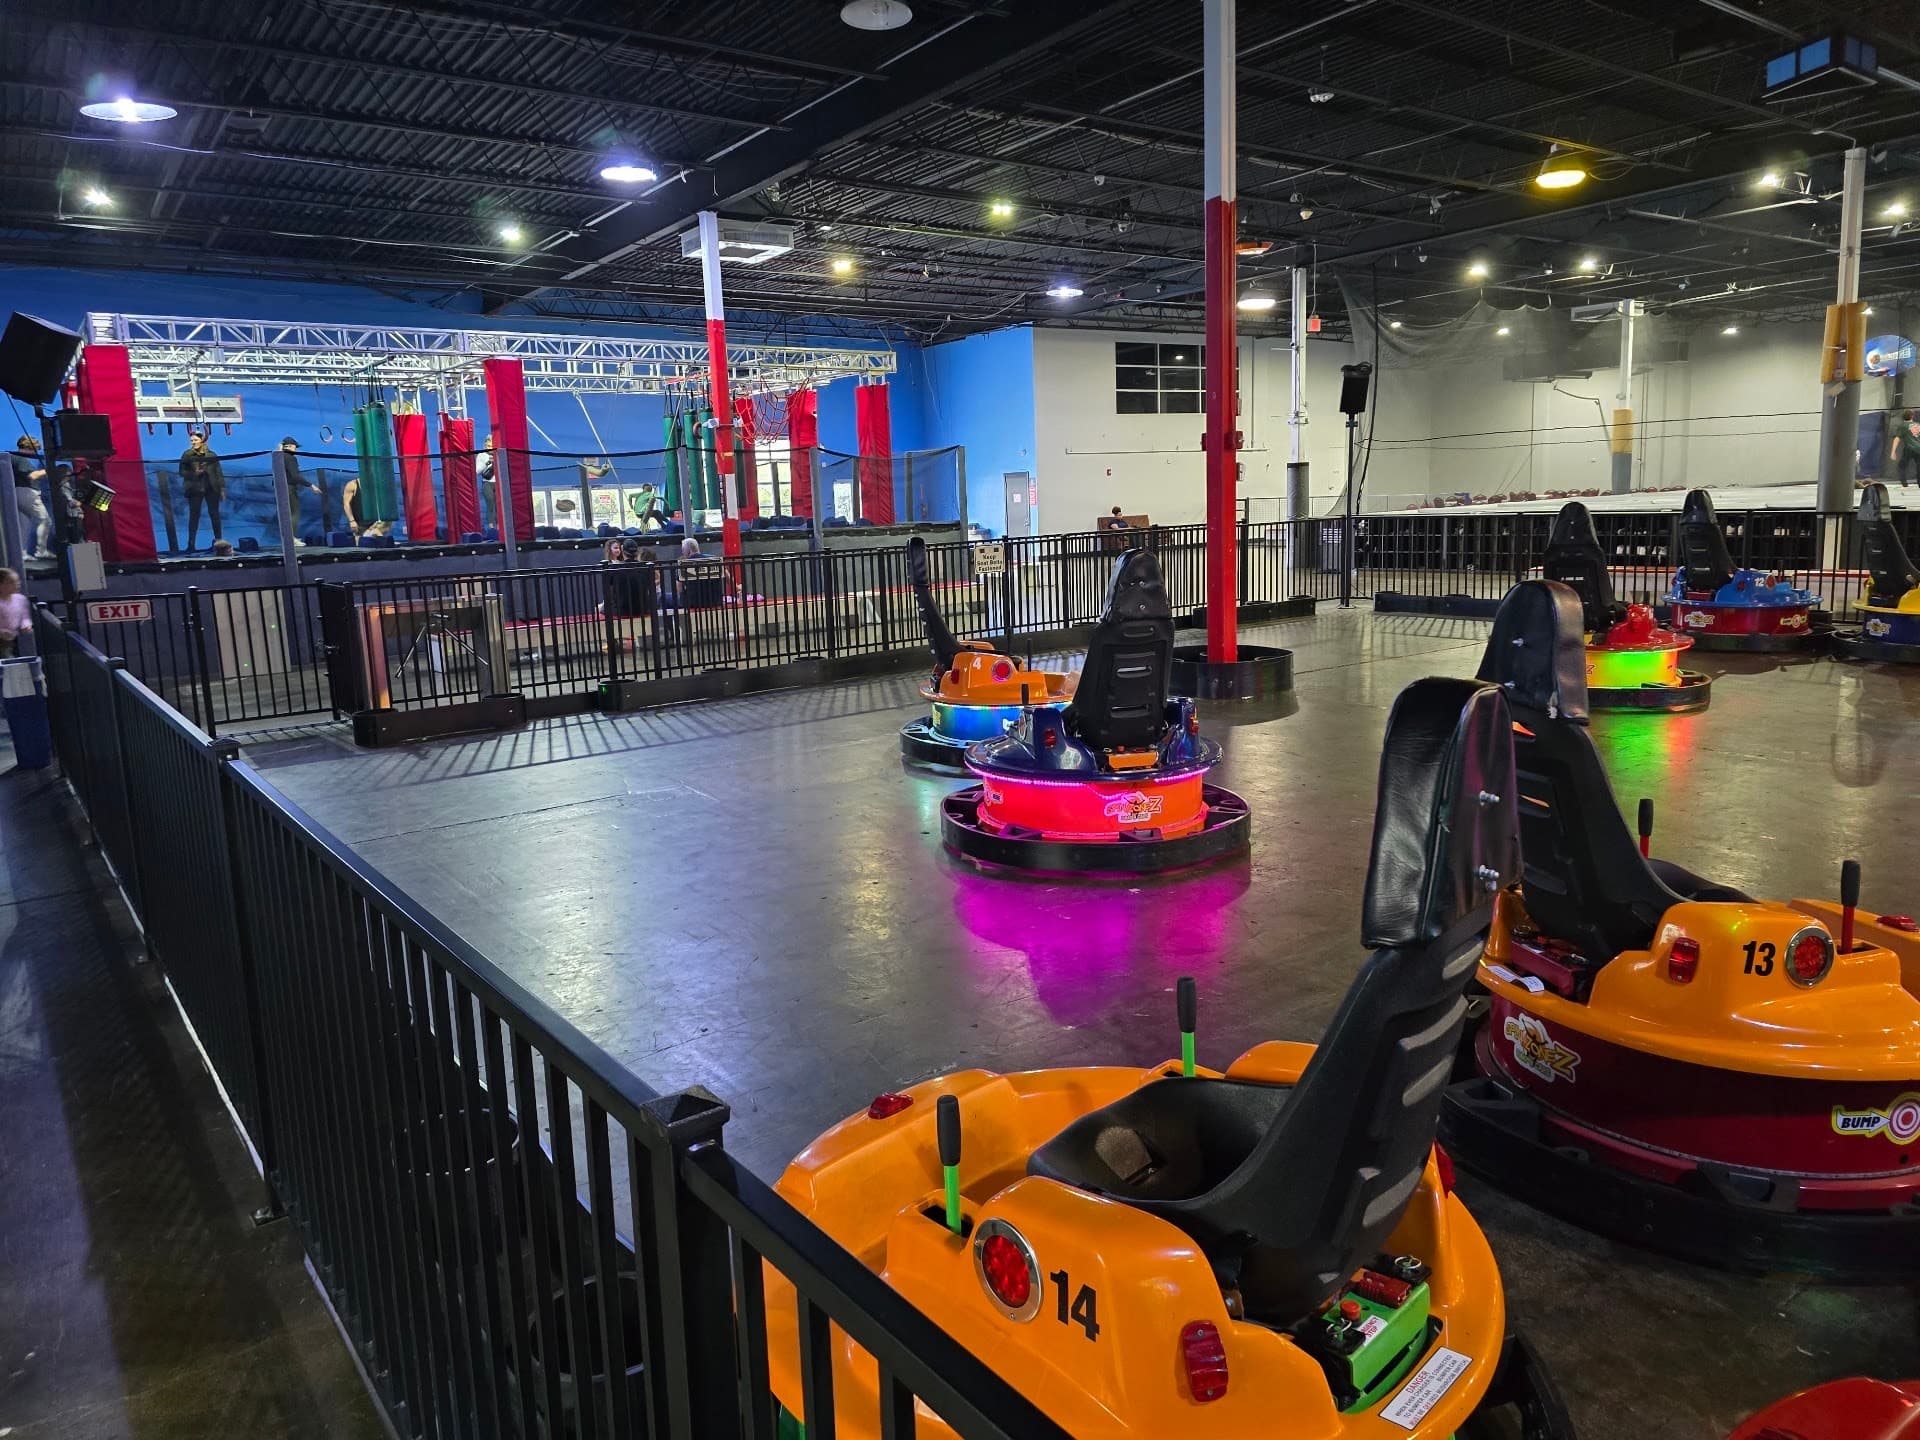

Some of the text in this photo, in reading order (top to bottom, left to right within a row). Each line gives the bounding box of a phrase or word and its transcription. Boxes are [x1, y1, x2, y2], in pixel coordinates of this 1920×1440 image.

[1754, 577, 1765, 587] 12
[98, 604, 141, 618] EXIT
[973, 657, 982, 669] 4
[1742, 940, 1776, 977] 13
[1841, 1116, 1881, 1129] BUMP
[1049, 1269, 1100, 1343] 14
[1405, 1370, 1430, 1394] DANGER
